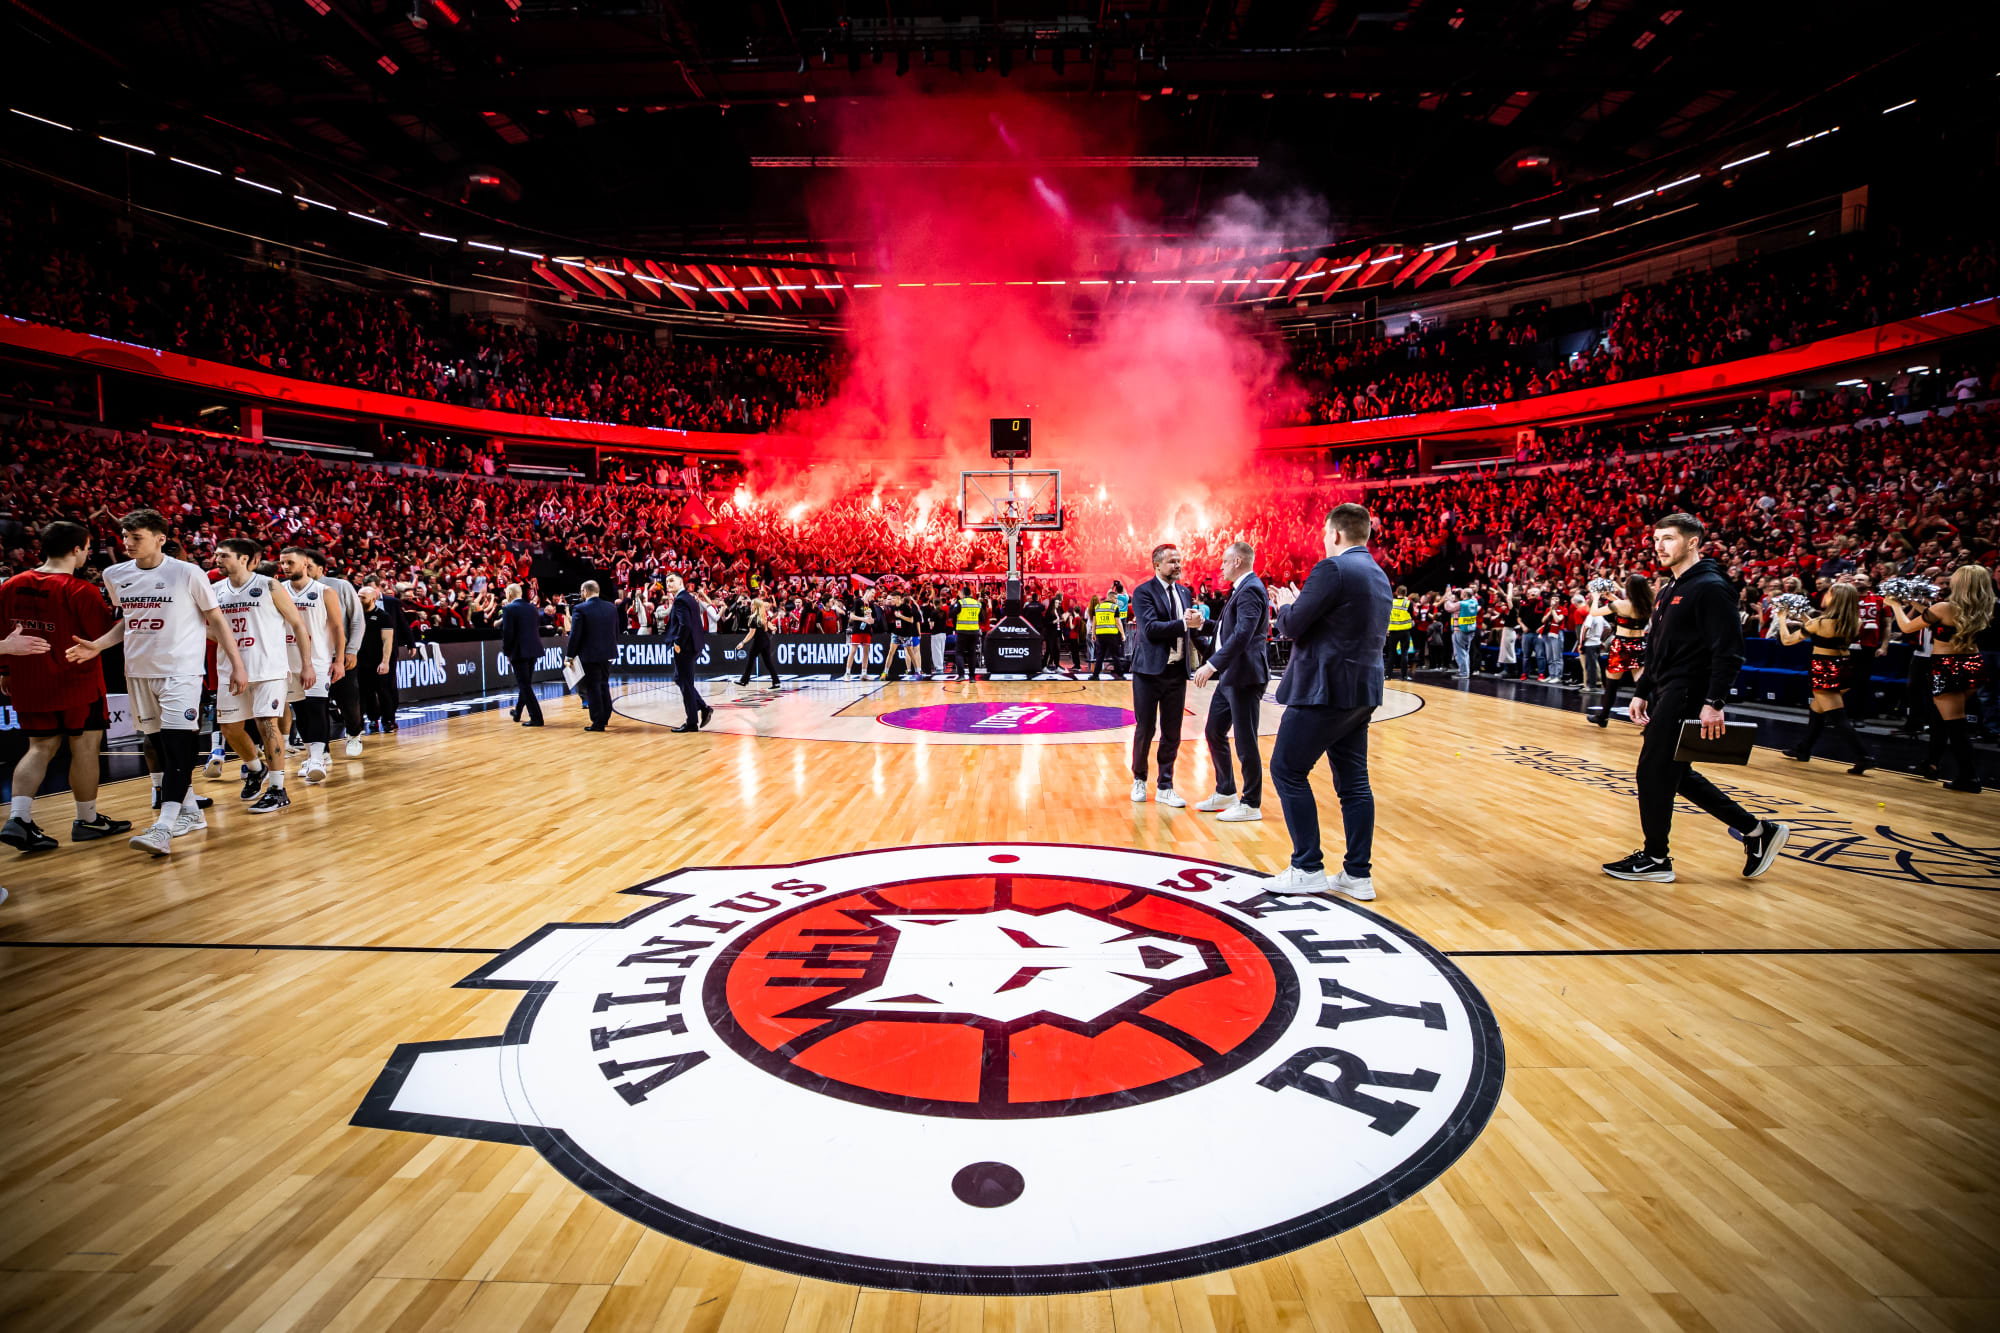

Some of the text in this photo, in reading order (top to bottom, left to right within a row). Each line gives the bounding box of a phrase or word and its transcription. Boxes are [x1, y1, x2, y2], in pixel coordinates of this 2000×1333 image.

[1012, 420, 1020, 431] 0
[129, 619, 164, 630] era
[232, 618, 247, 633] 32
[777, 643, 796, 665] OF
[998, 647, 1030, 656] UTENOS
[591, 868, 1448, 1137] VILNIUS RYTAS
